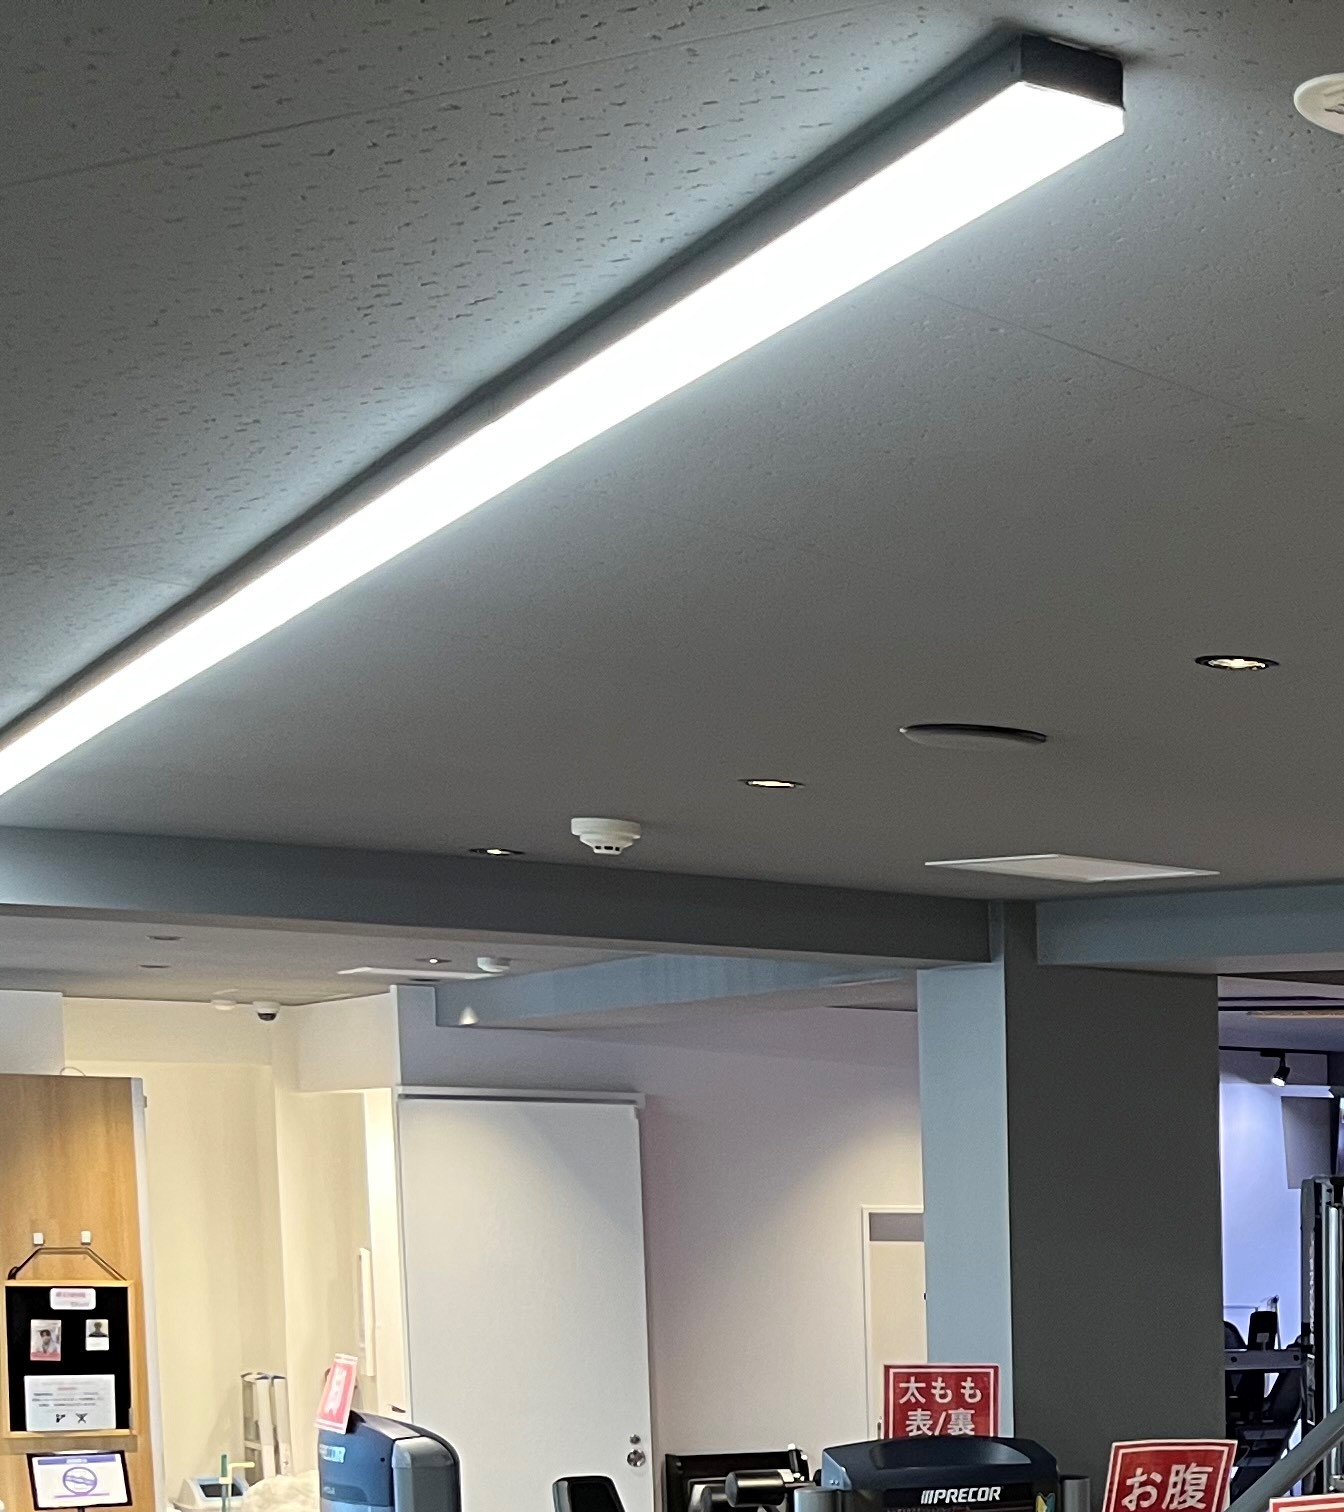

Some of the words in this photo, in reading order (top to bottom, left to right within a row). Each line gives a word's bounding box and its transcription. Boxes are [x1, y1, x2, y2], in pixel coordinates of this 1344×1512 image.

[899, 1376, 982, 1404] 太もも
[906, 1408, 976, 1436] 表/裏
[932, 1486, 1002, 1504] PRECOR
[1121, 1463, 1213, 1511] お腹
